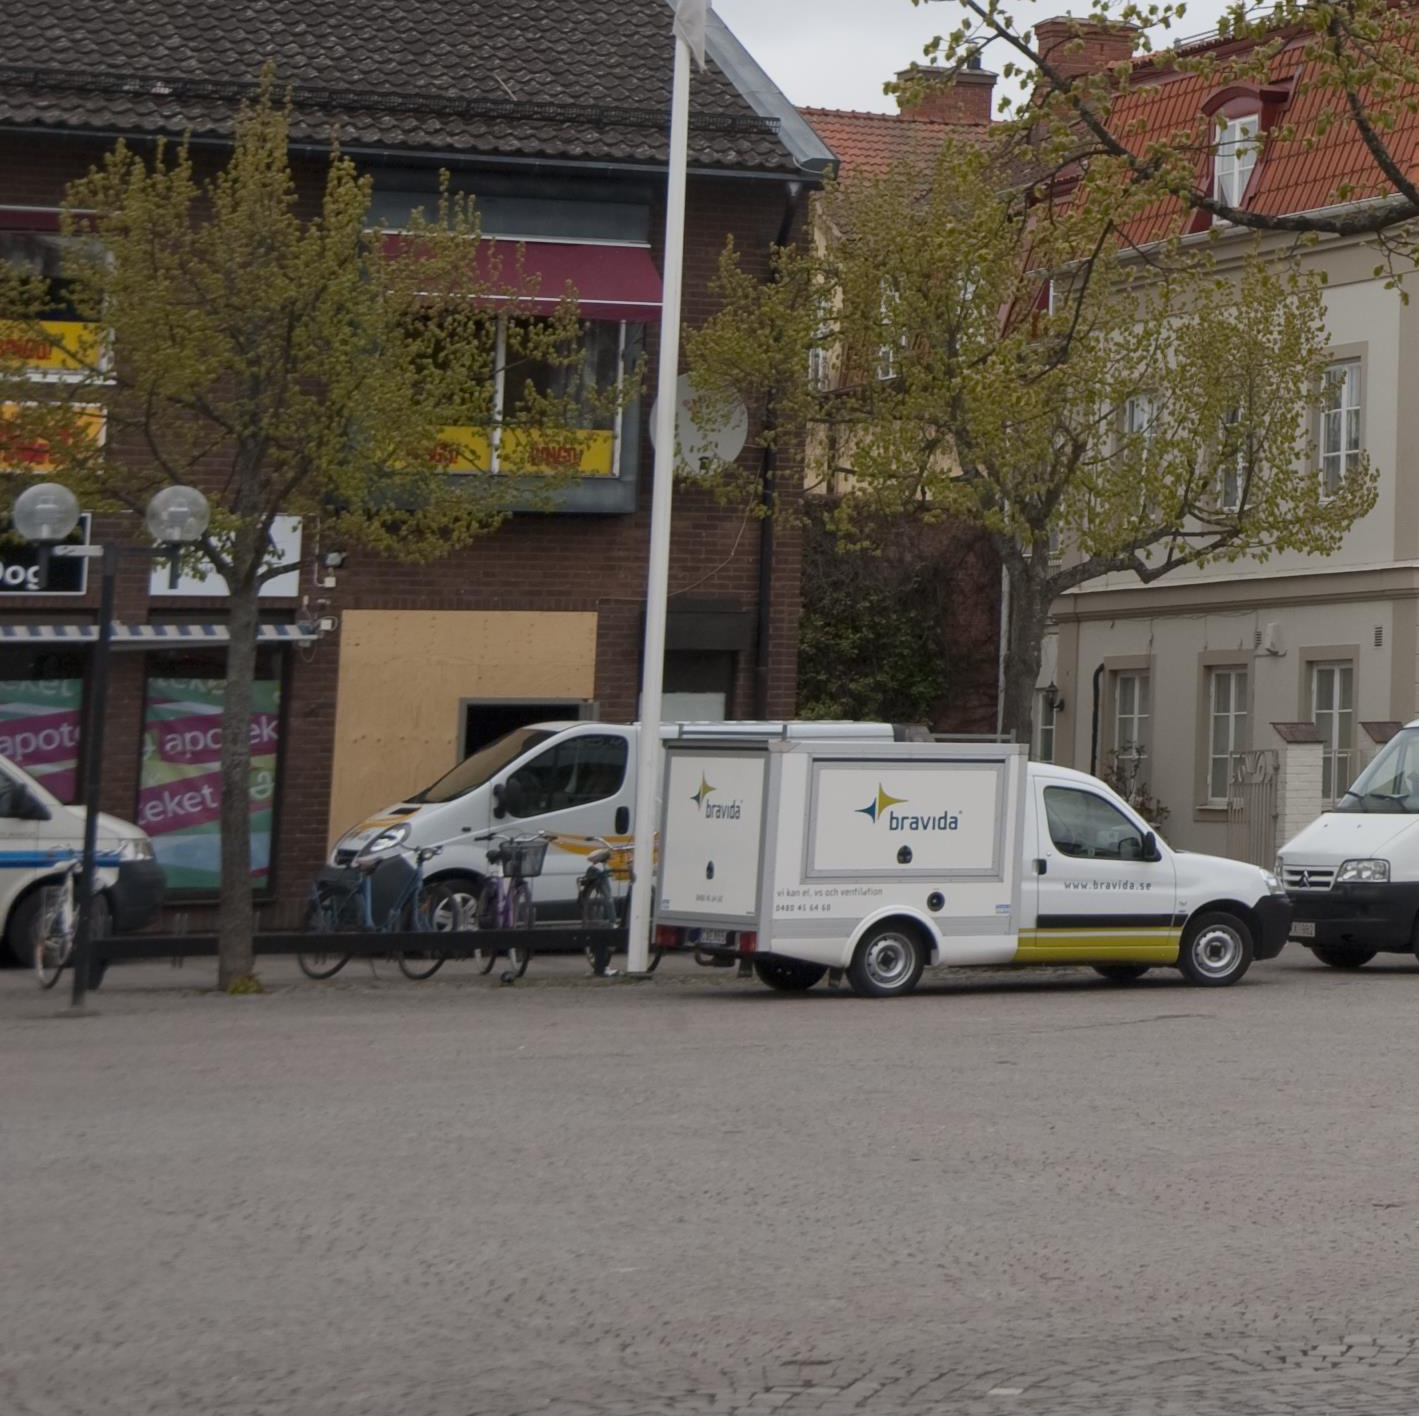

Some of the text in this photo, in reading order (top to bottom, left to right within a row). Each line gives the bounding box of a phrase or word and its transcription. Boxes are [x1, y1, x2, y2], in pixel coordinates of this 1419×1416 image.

[165, 715, 279, 760] apoek
[705, 799, 741, 820] bravida
[889, 810, 959, 831] bravida
[786, 888, 801, 897] kan
[825, 888, 838, 897] och
[840, 887, 883, 897] ventilation
[1064, 879, 1153, 891] www.bravida.se
